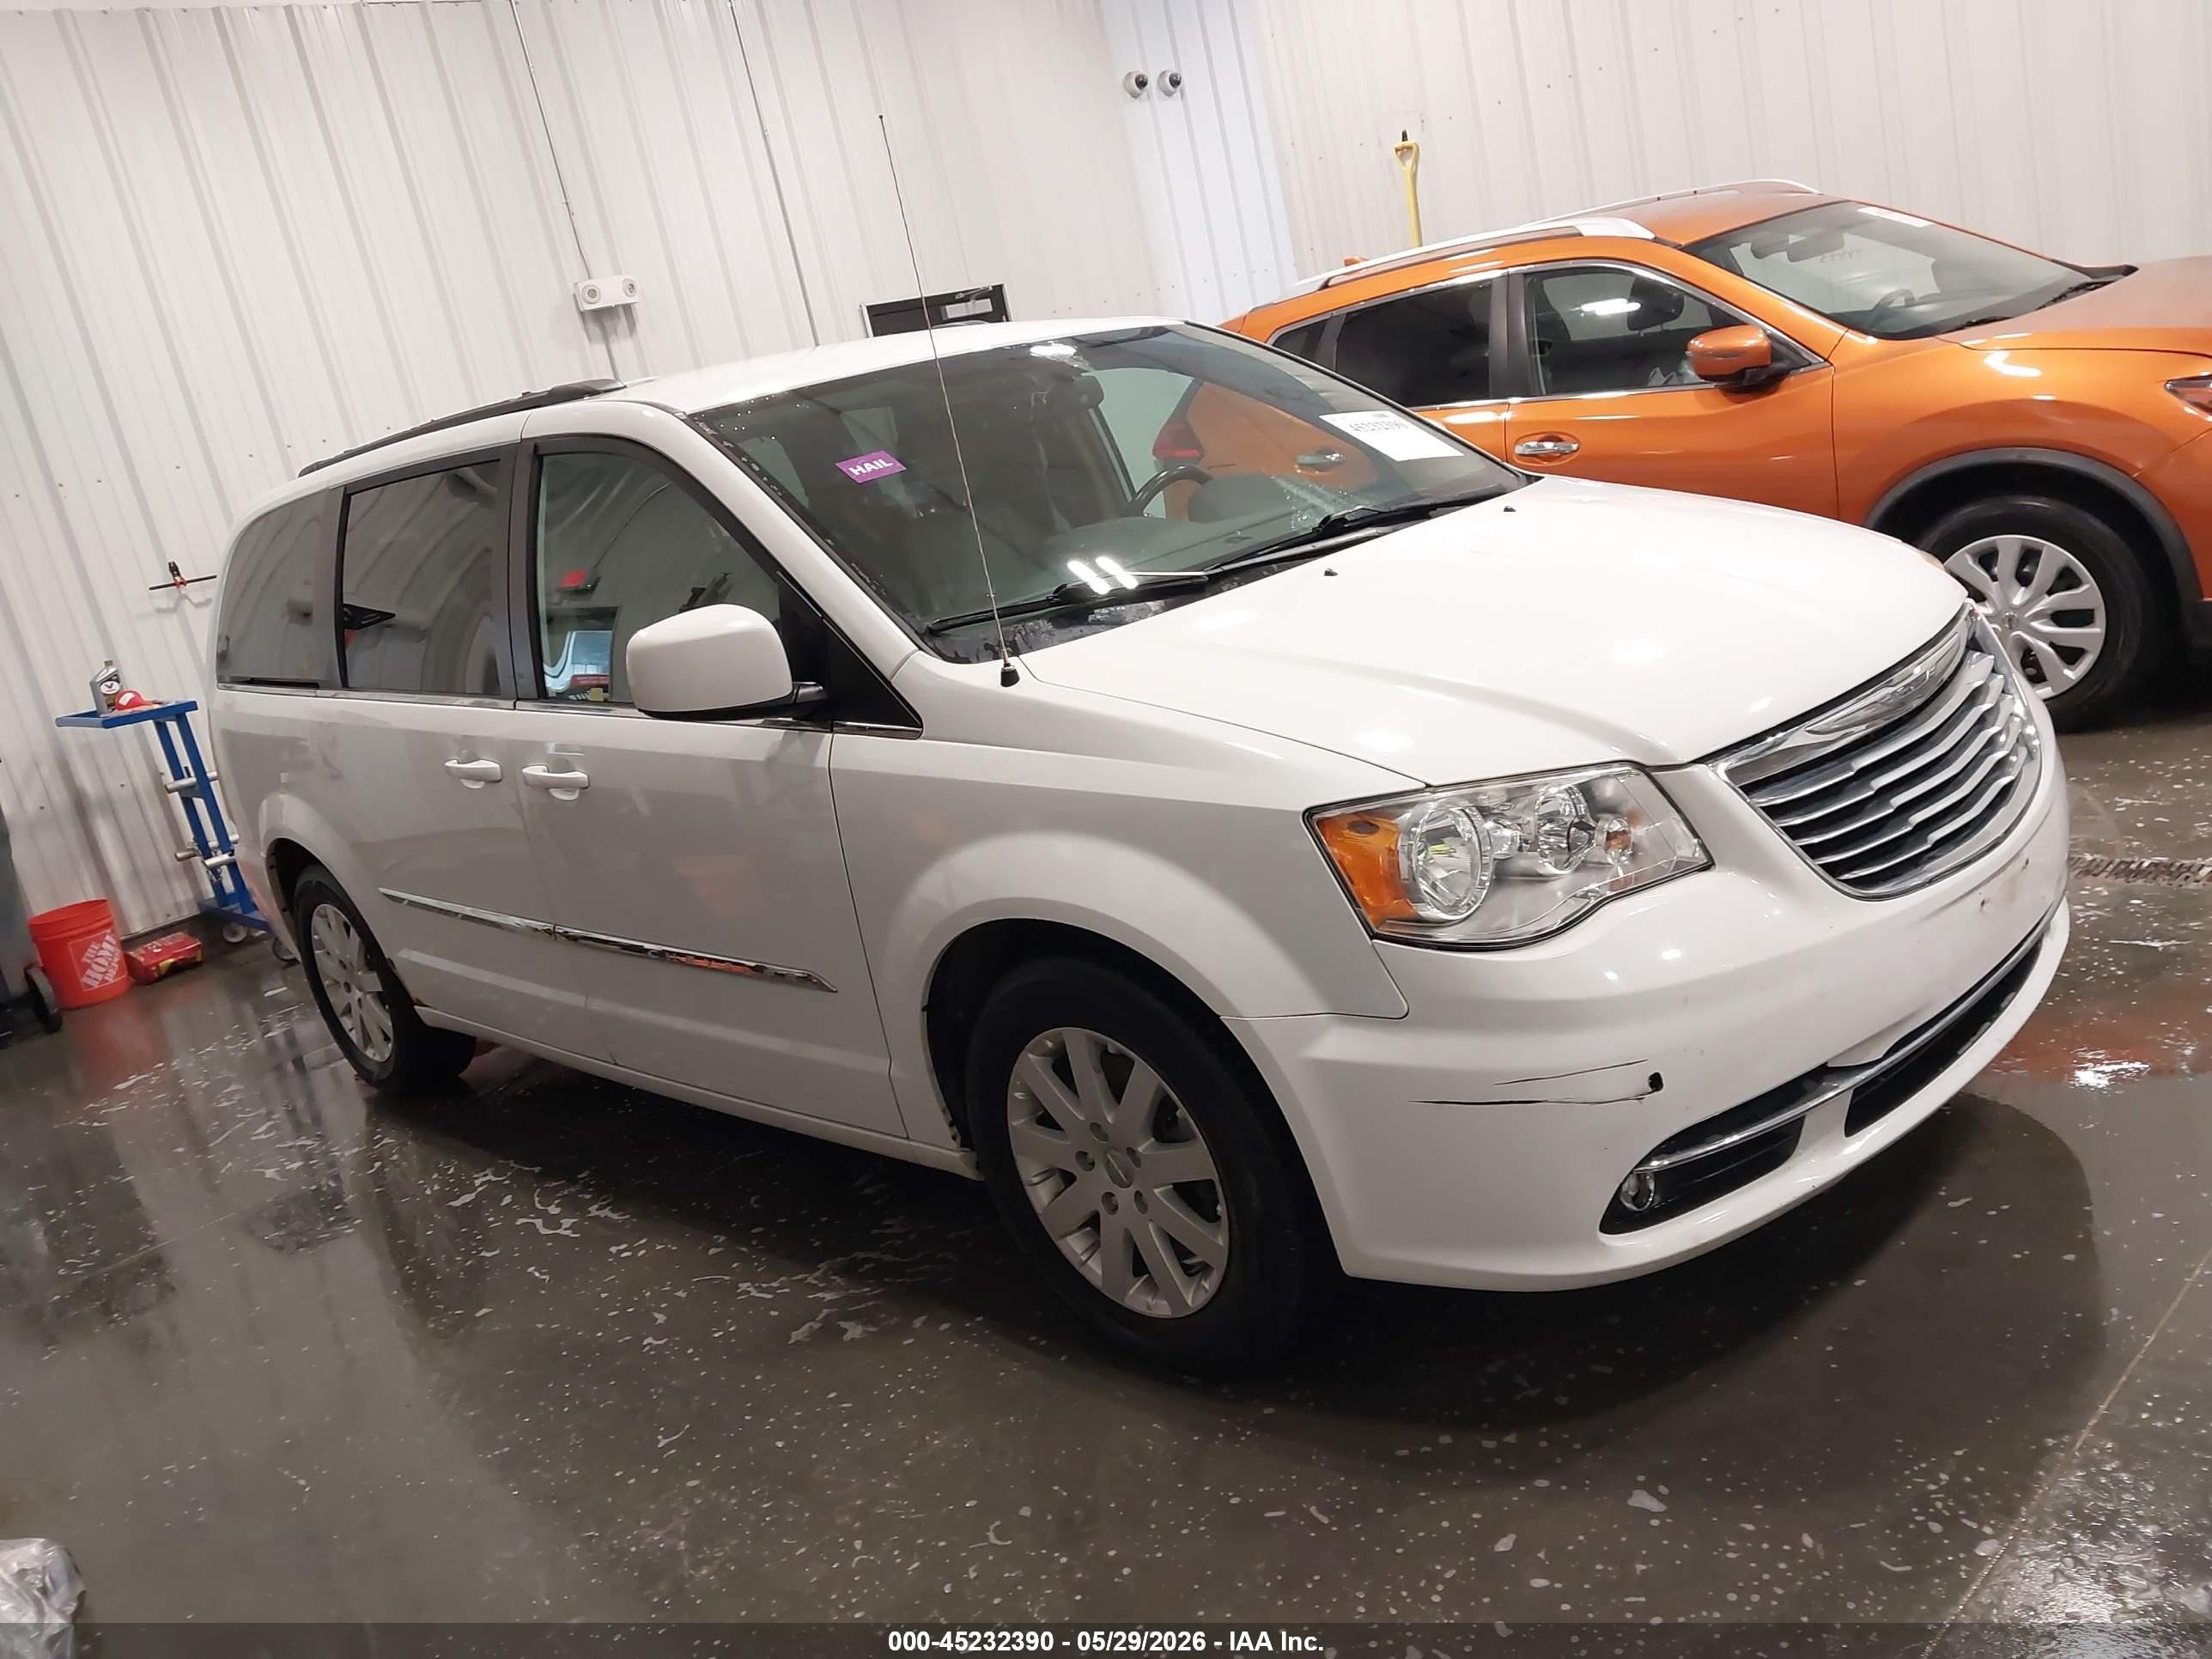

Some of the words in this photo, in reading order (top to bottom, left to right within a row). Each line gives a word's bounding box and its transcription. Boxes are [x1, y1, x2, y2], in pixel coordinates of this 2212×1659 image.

[848, 459, 894, 476] HAIL
[82, 941, 100, 963] THE
[82, 934, 117, 988] HOME
